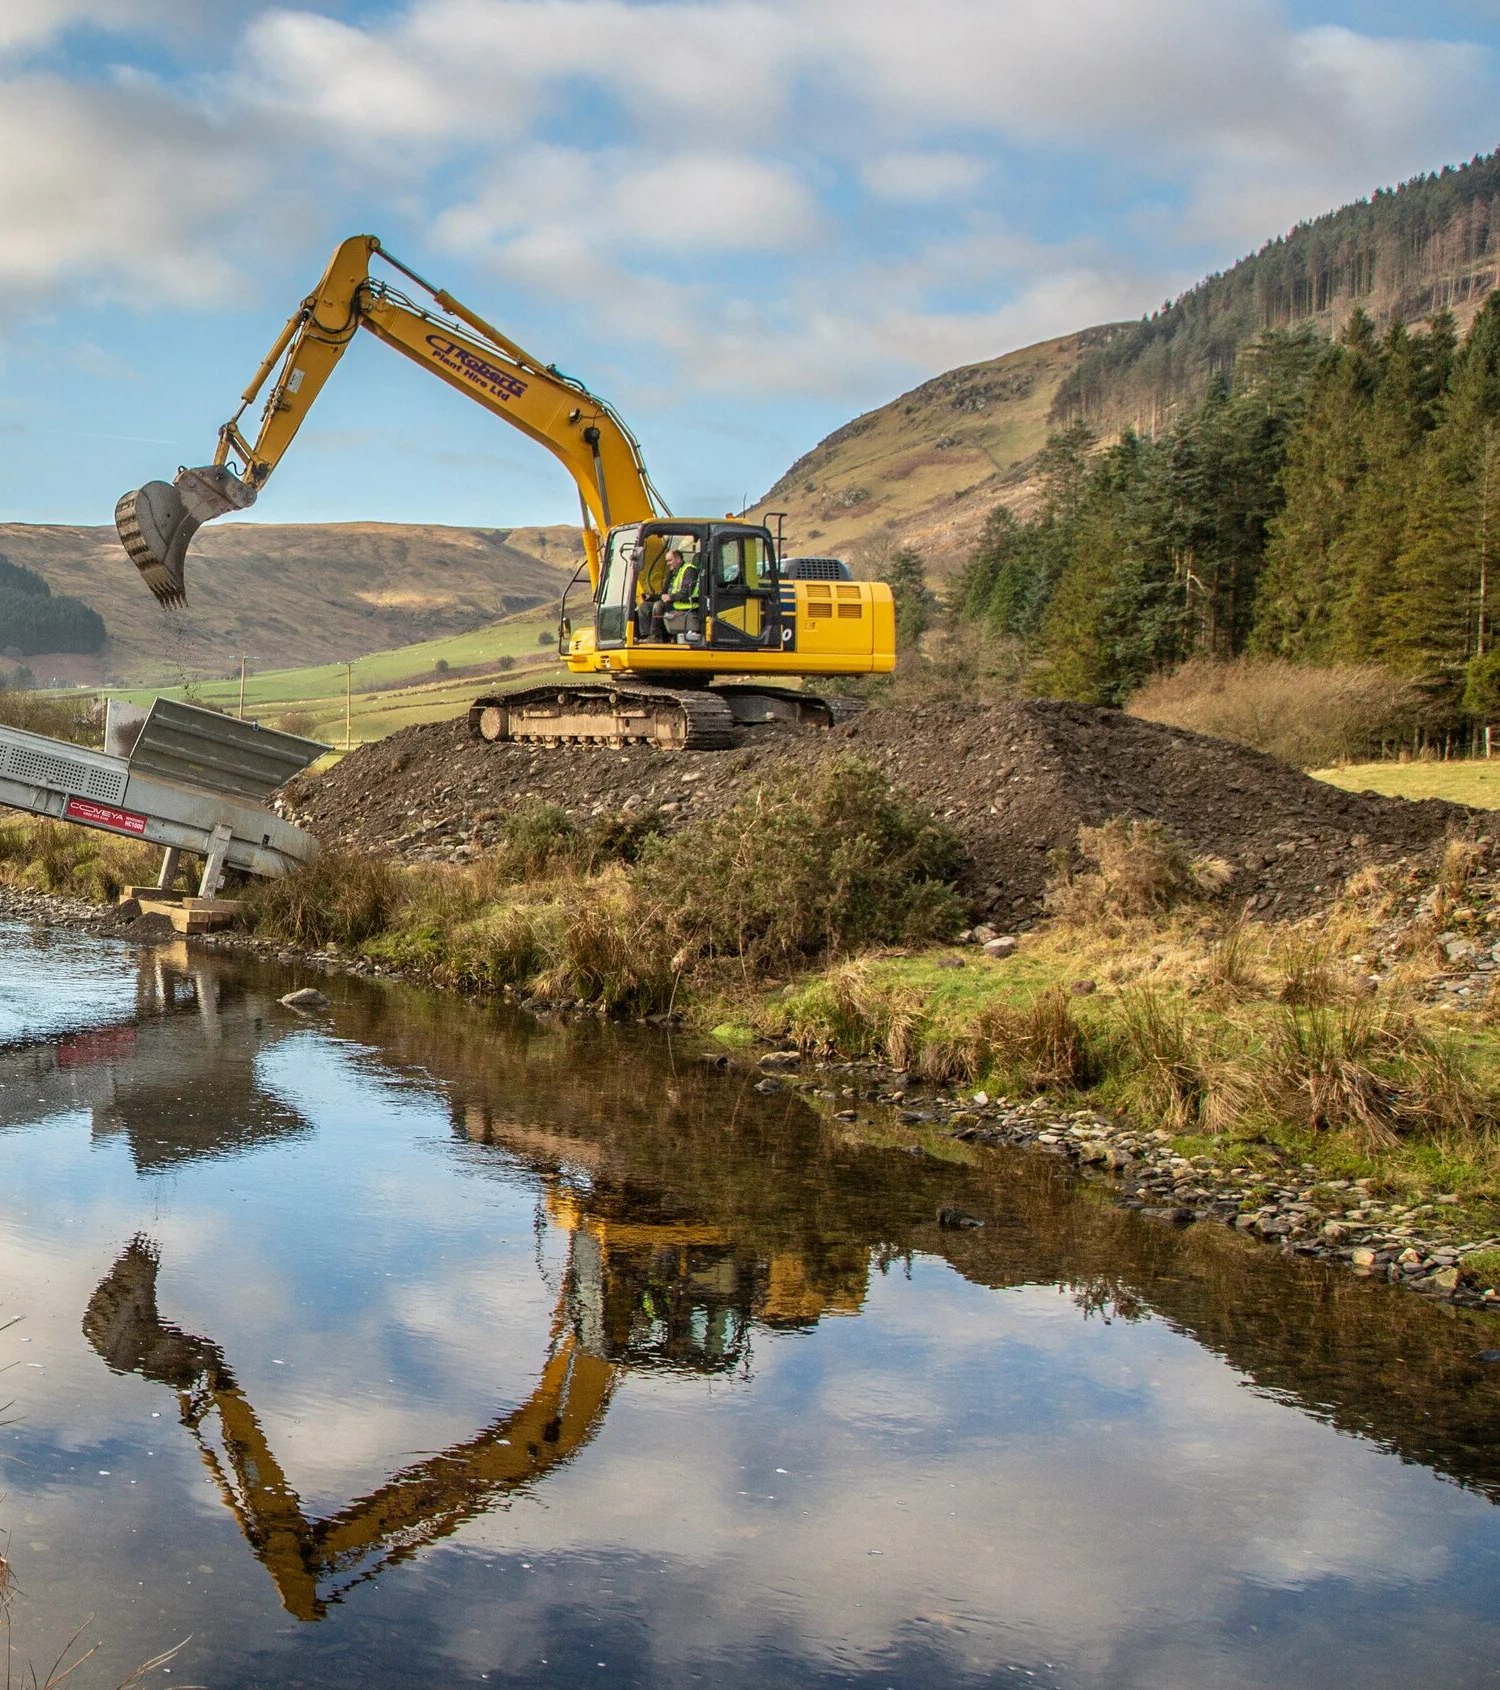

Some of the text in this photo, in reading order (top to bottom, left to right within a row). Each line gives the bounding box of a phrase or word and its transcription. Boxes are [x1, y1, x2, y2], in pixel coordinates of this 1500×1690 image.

[432, 350, 511, 401] Plant Hire Ltd
[70, 801, 124, 821] COVEYA
